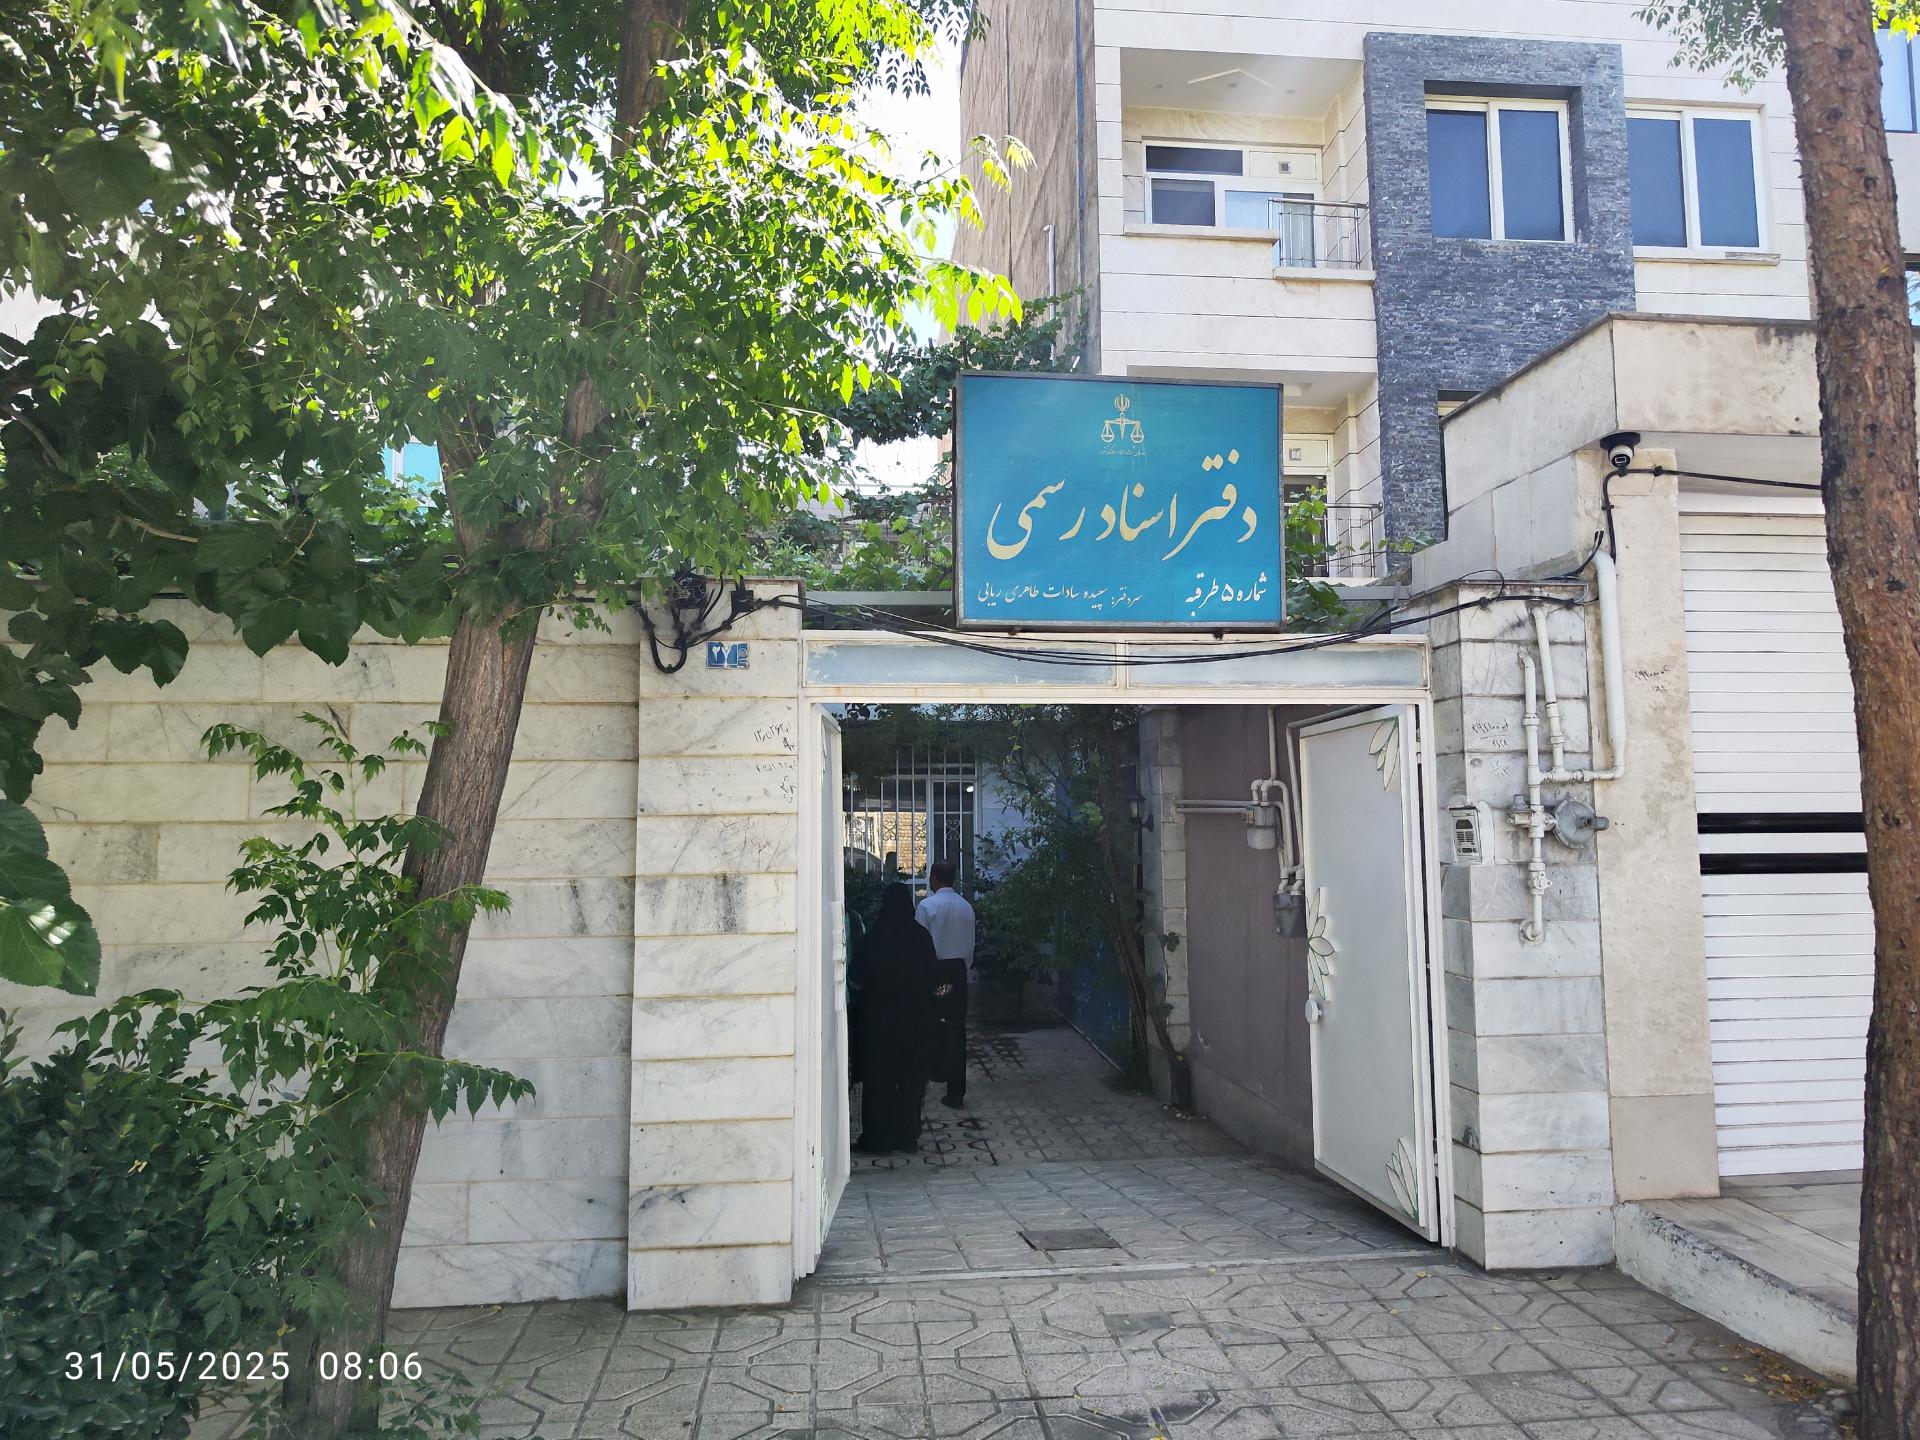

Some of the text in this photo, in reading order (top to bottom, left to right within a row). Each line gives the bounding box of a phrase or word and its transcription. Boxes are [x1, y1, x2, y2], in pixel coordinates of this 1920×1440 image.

[986, 449, 1257, 561] دفتر اسناد رسمی
[1004, 583, 1039, 603] طاهری
[1042, 583, 1080, 599] سادات
[1083, 587, 1109, 610] سپیده
[1184, 571, 1267, 617] شماره ۵ طرقبه
